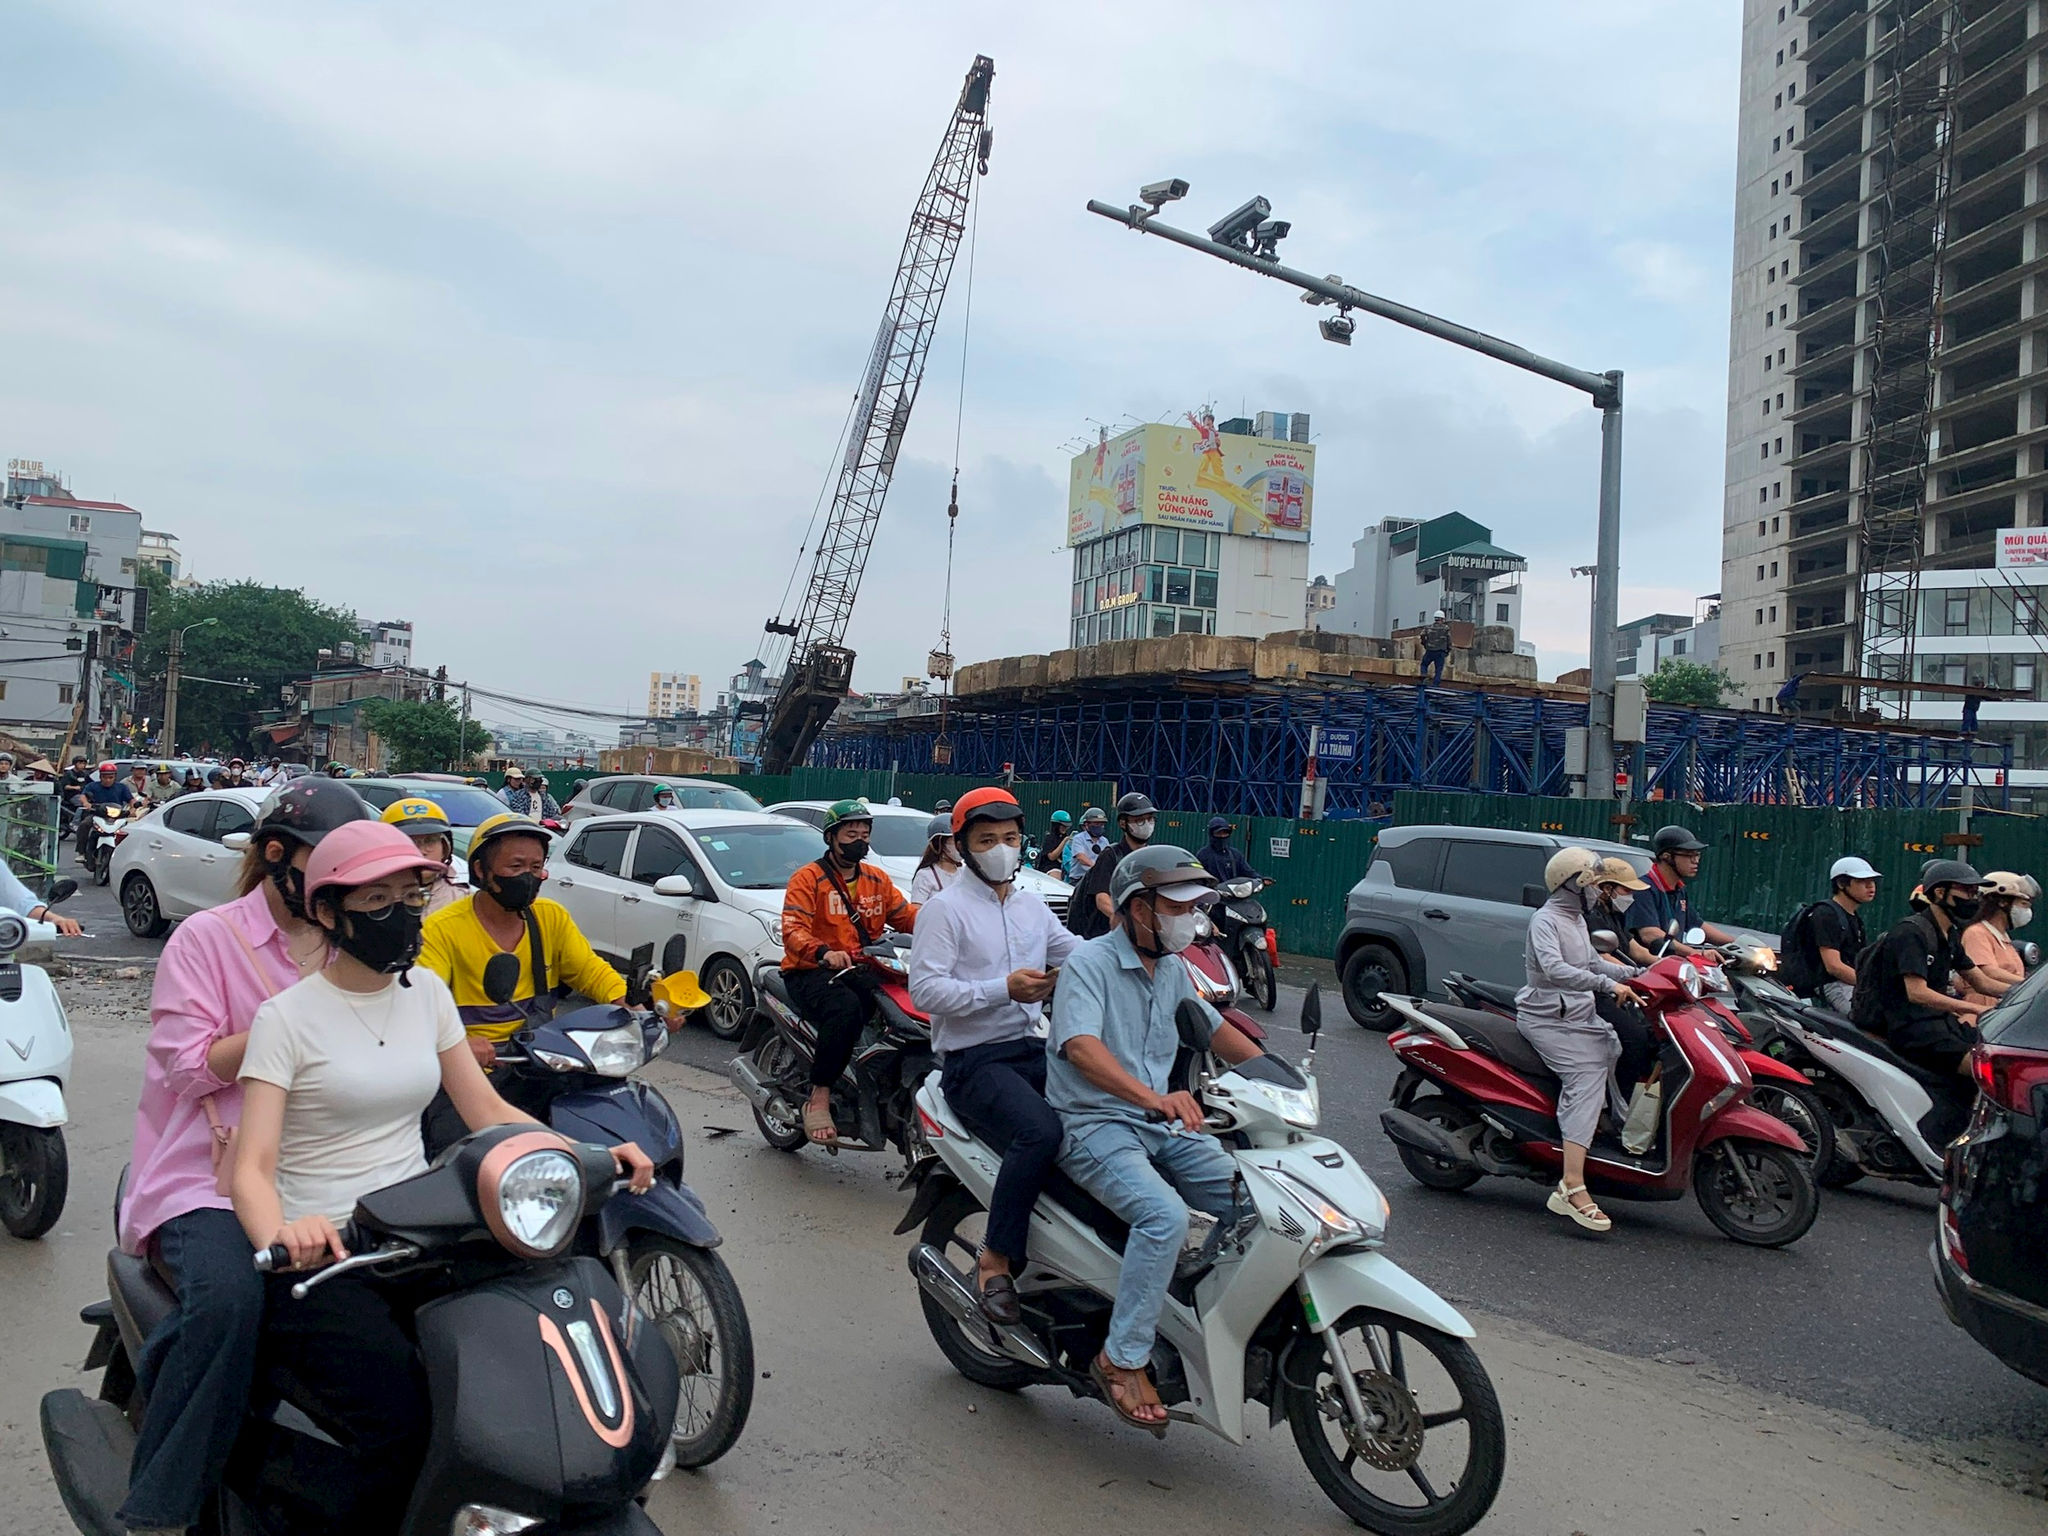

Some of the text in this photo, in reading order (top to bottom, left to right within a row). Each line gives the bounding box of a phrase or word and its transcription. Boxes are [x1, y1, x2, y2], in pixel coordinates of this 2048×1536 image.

[20, 460, 43, 471] BLUE
[1158, 492, 1208, 506] CÂN NẶNG
[1158, 503, 1213, 518] VỮNG VÀNG
[1470, 554, 1493, 569] PHẨM
[1494, 558, 1509, 570] TÂM
[1118, 592, 1138, 605] GROUP
[1319, 741, 1352, 756] LA THÀNH
[402, 803, 428, 816] be
[1269, 1226, 1303, 1244] HONDA
